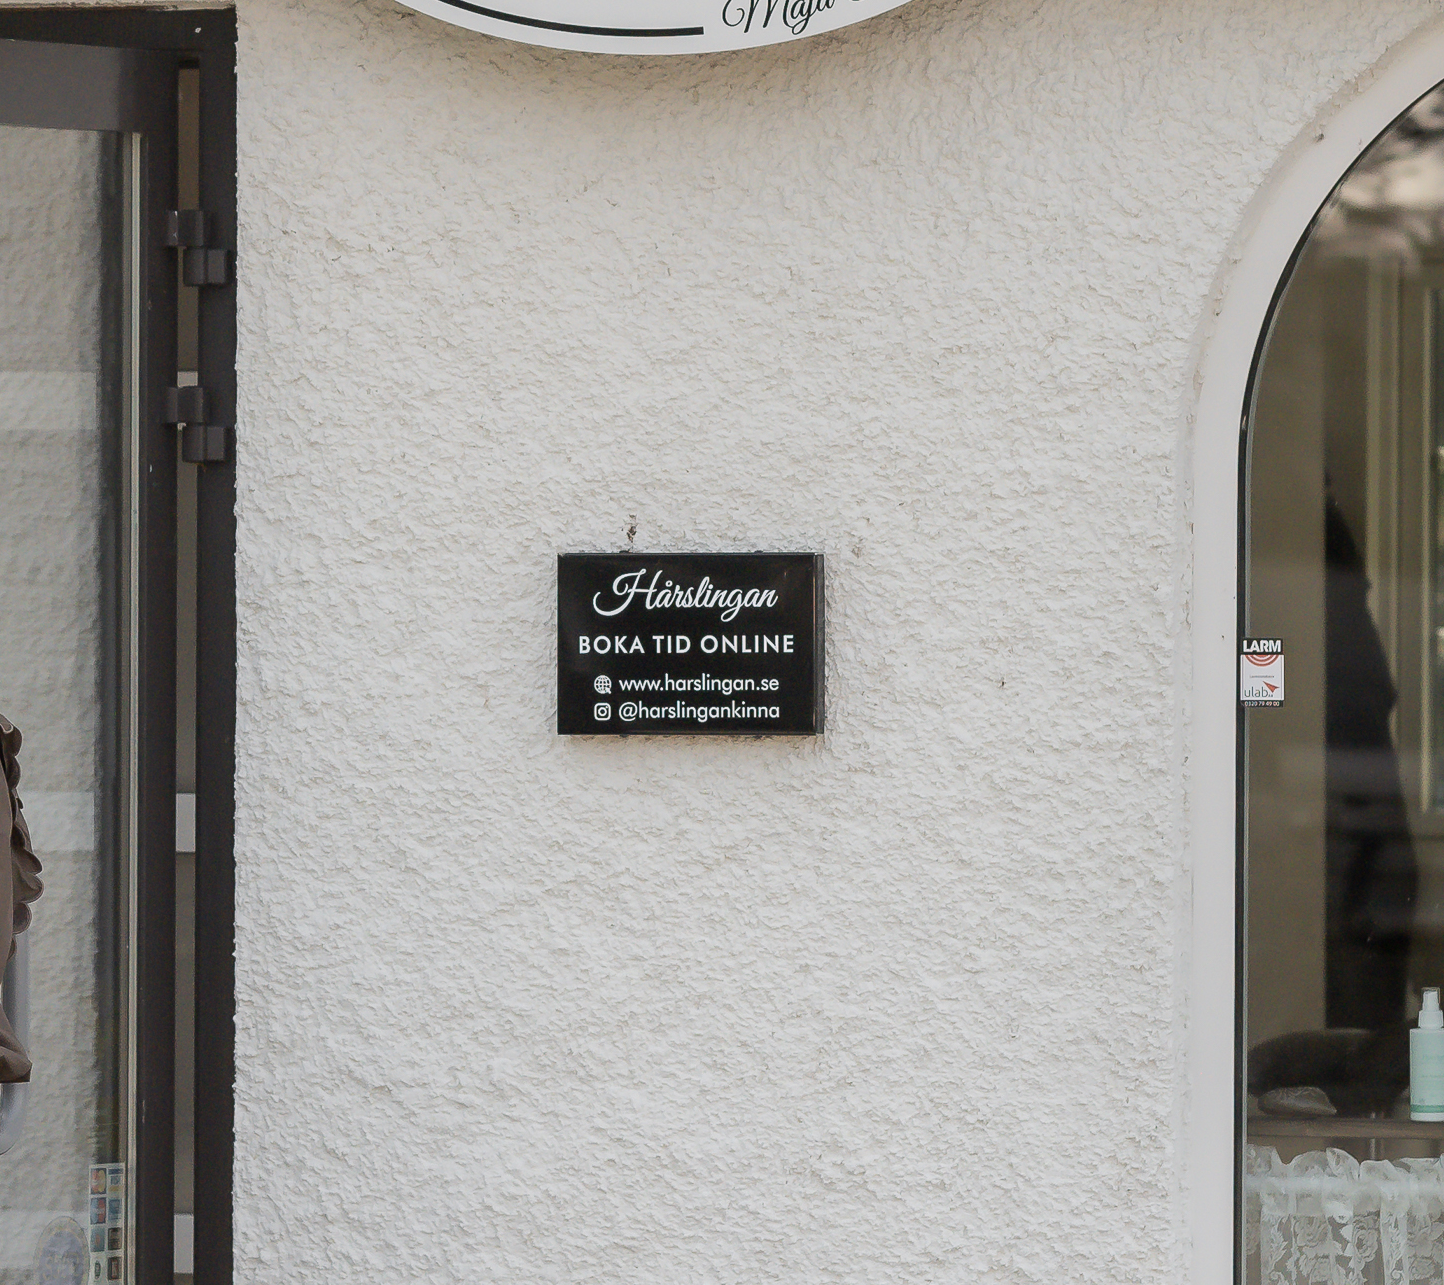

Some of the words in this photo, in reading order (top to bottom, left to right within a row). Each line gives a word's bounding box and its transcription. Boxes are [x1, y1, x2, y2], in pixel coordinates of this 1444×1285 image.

[592, 568, 779, 622] Hårslingan
[578, 635, 645, 654] BOKA
[652, 635, 691, 654] TID
[700, 634, 794, 653] ONLINE
[1243, 640, 1281, 653] LARM
[618, 673, 779, 695] www.harslingan.se
[618, 700, 780, 723] @harslingankinna
